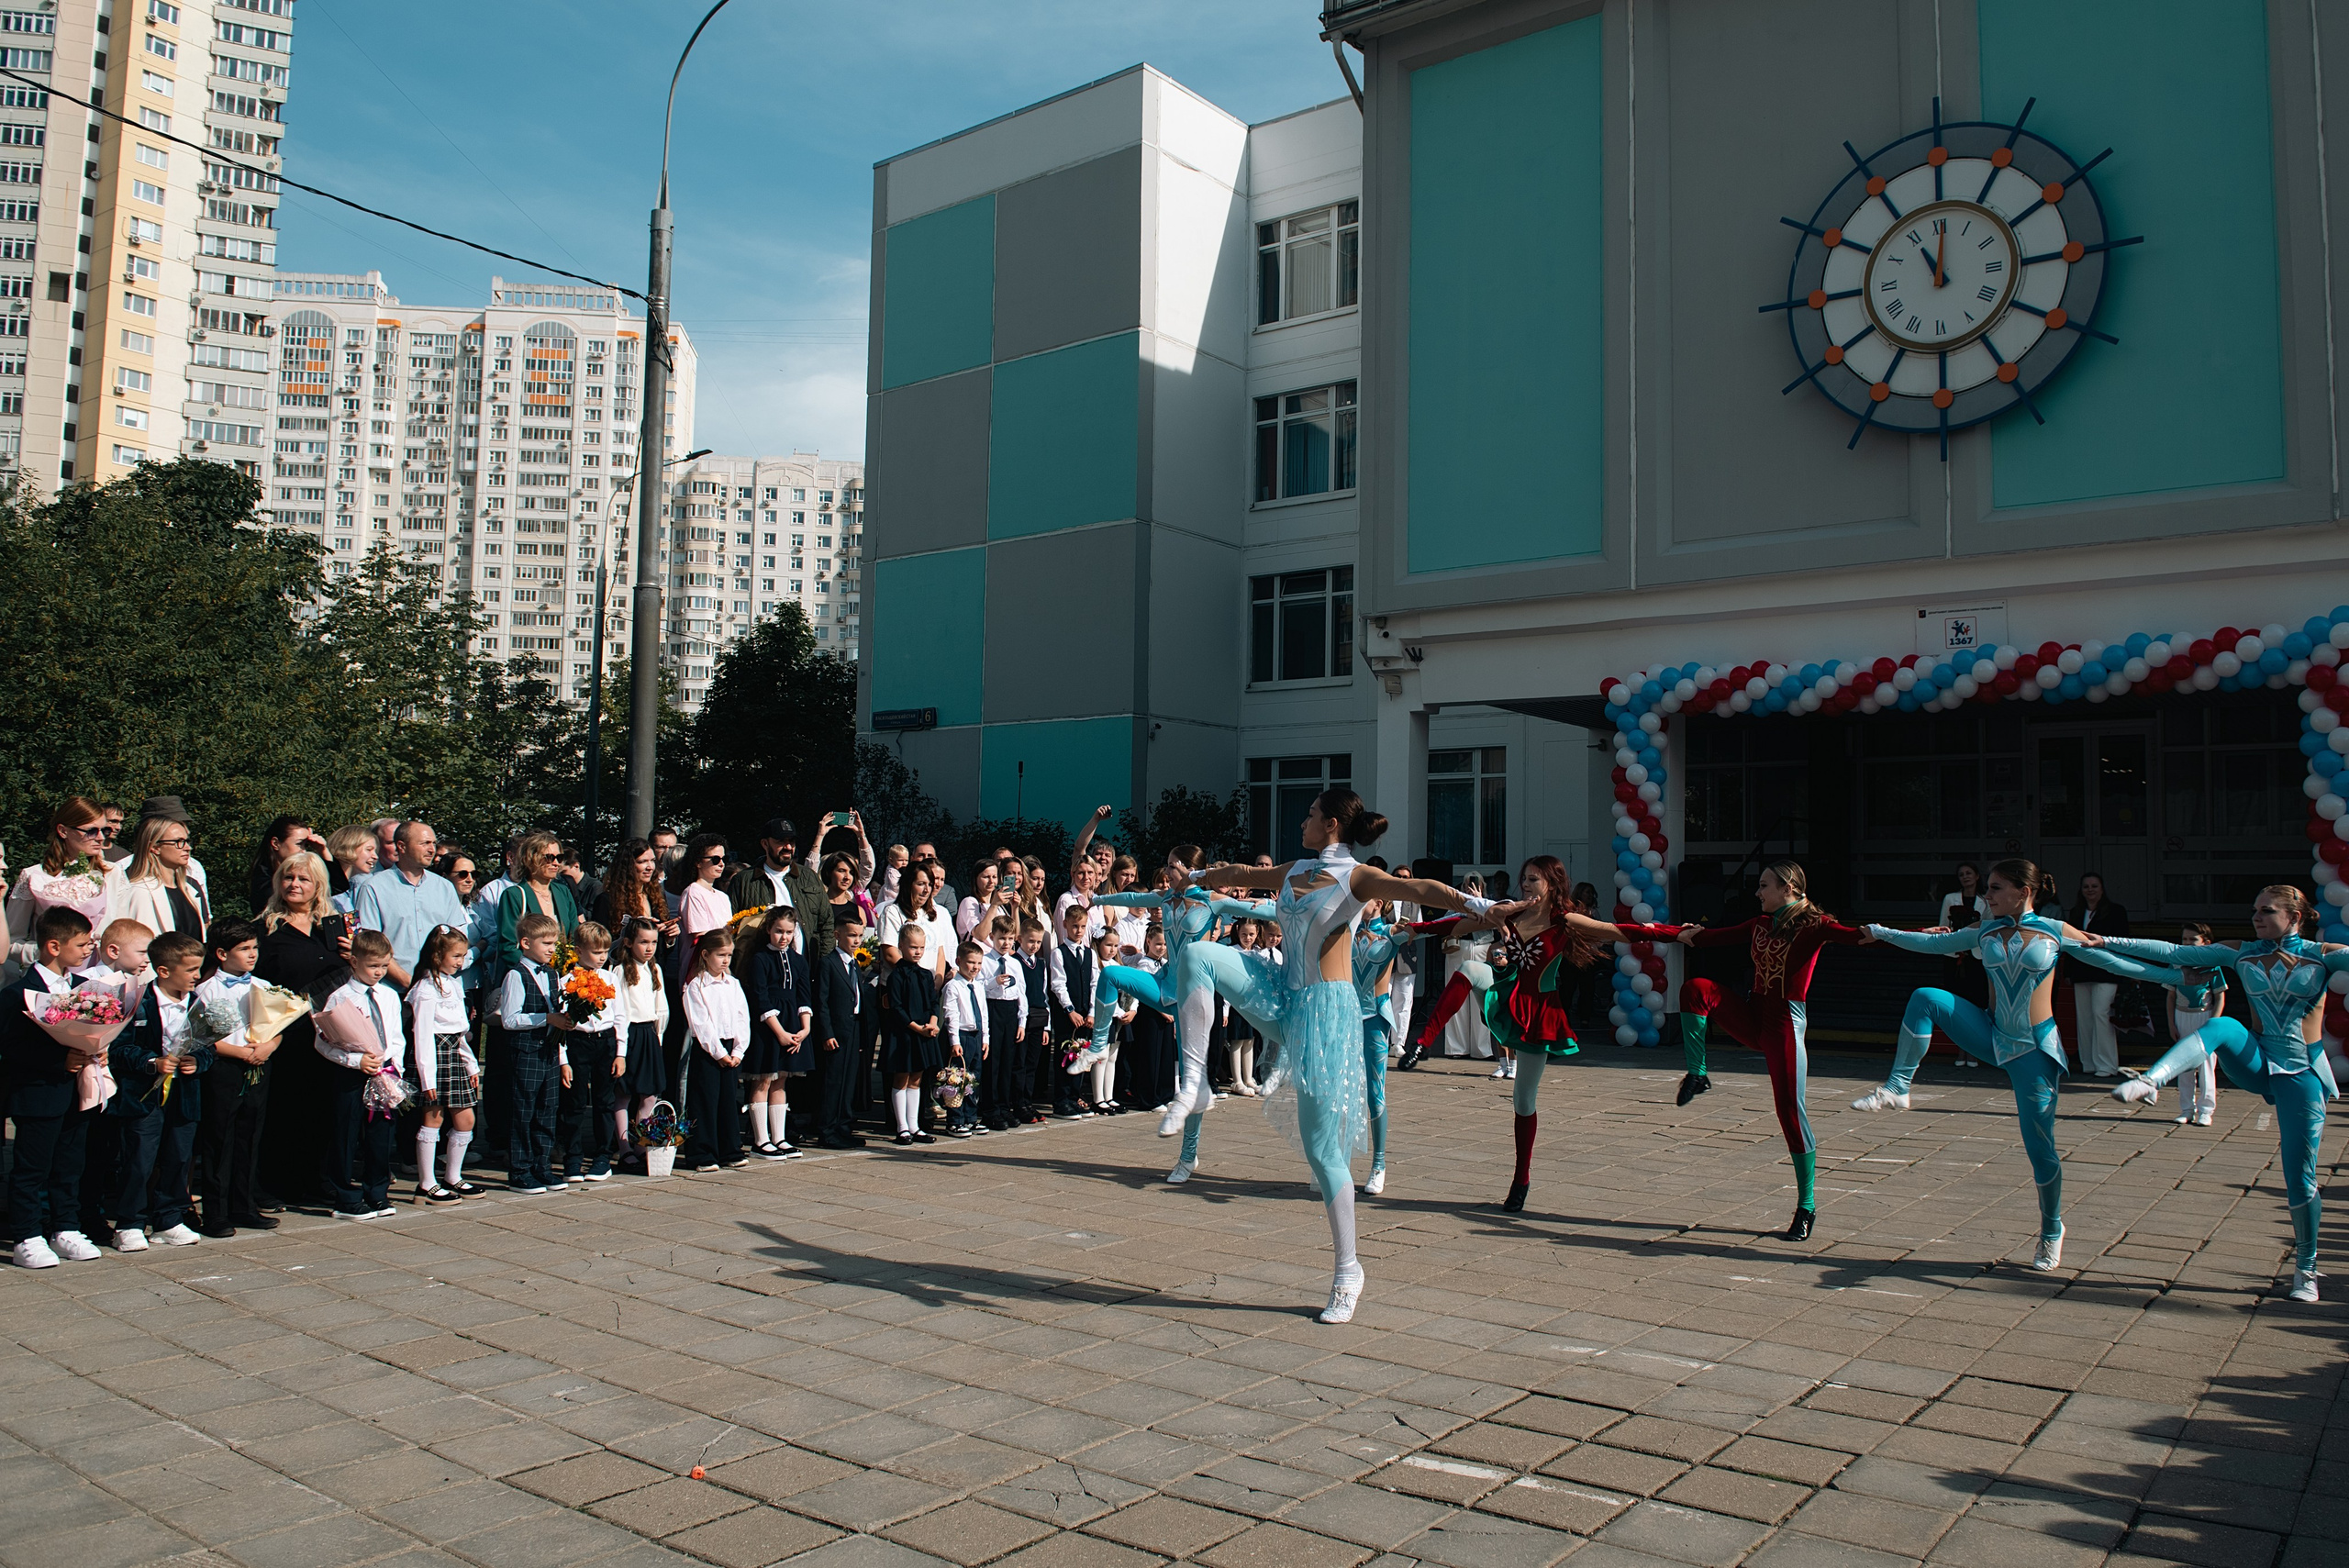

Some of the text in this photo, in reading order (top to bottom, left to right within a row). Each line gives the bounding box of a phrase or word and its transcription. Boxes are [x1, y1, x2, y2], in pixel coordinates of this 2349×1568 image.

[1961, 221, 1971, 236] I
[1906, 229, 1922, 247] XI
[1978, 236, 1995, 250] II
[1887, 254, 1904, 265] X
[1986, 261, 2002, 273] III
[1881, 280, 1897, 292] IX
[1976, 285, 1998, 303] IIII
[1885, 298, 1905, 320] VIII
[1964, 310, 1975, 324] V
[1905, 316, 1921, 334] VII
[1935, 320, 1946, 336] VI
[1949, 637, 1974, 646] 1367
[925, 710, 931, 722] 6
